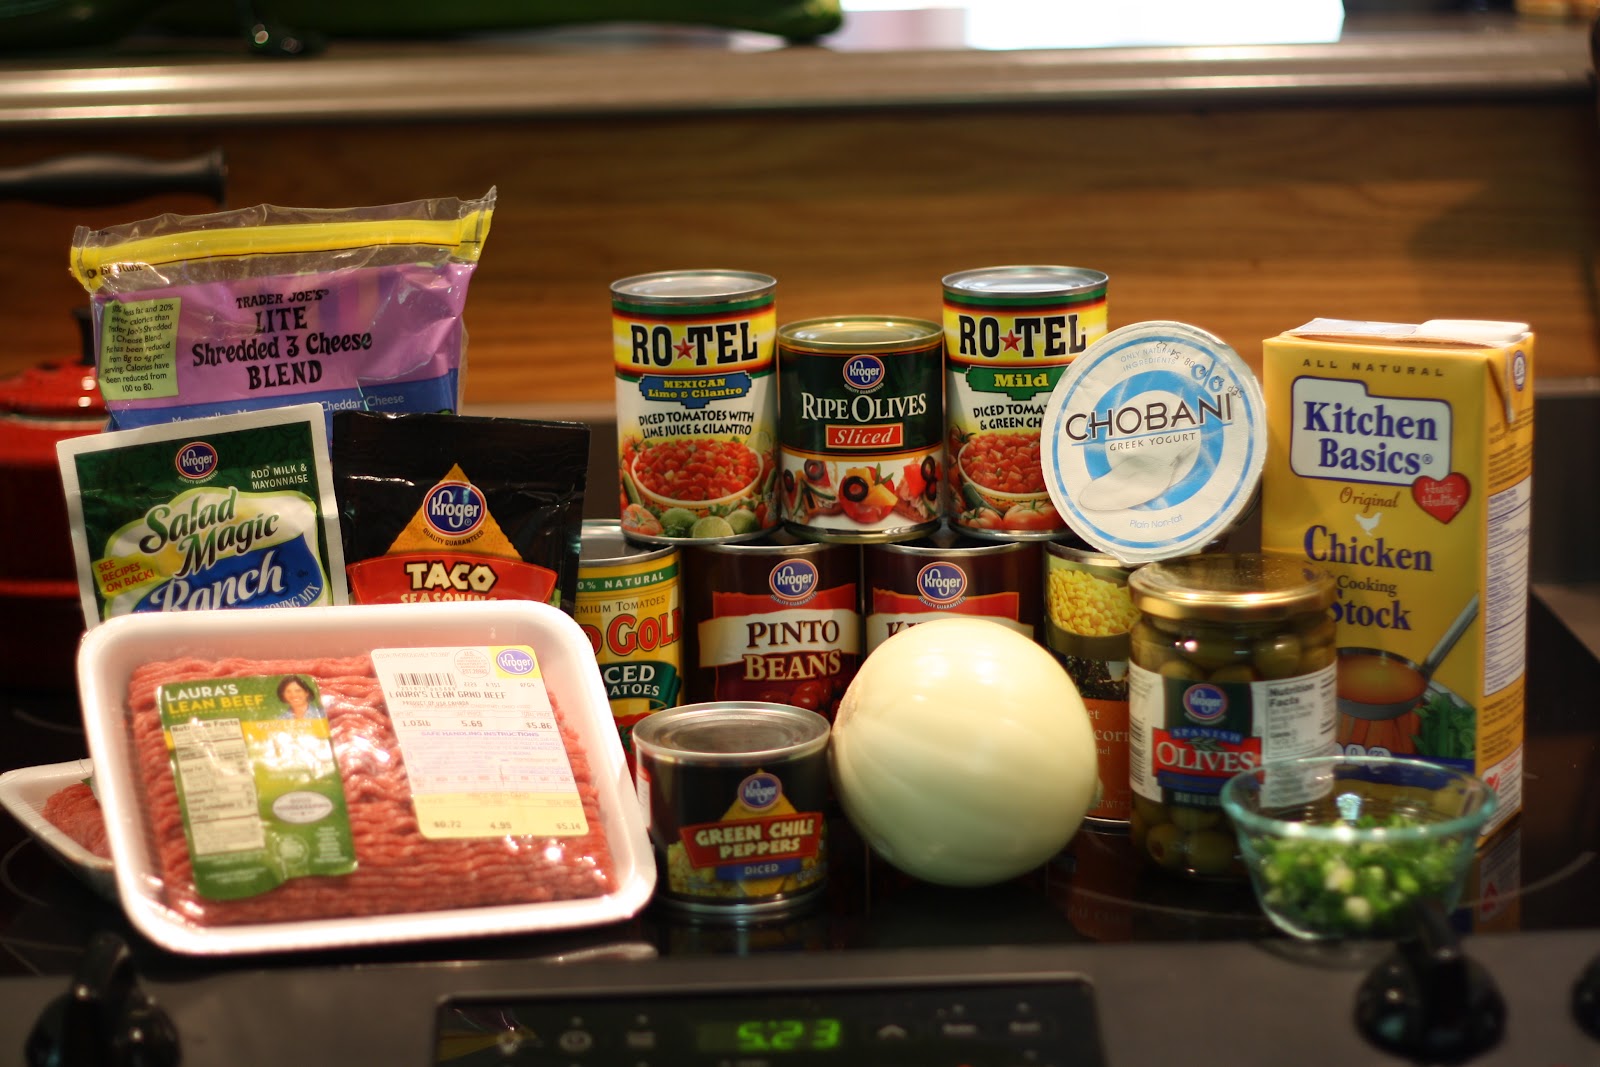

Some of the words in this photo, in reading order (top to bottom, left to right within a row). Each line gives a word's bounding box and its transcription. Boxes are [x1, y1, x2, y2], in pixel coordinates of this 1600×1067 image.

[236, 294, 284, 309] TRADER
[288, 289, 325, 303] JOE'S
[145, 305, 158, 313] and
[143, 323, 173, 333] Shredded
[254, 306, 308, 333] LITE
[116, 335, 143, 343] Cheese
[145, 342, 171, 352] reduced
[192, 336, 280, 366] Shredded
[286, 335, 299, 357] 3
[305, 331, 372, 355] Cheese
[1120, 350, 1141, 363] ONLY
[153, 354, 165, 362] per
[1122, 356, 1176, 372] INGREDIENTS
[122, 373, 149, 381] reduced
[150, 372, 167, 380] from
[126, 364, 153, 372] Calories
[246, 360, 322, 390] BLEND
[849, 360, 880, 384] Kroger
[1302, 358, 1338, 369] ALL
[1351, 361, 1445, 377] NATURAL
[122, 384, 133, 392] 100
[663, 378, 726, 389] MEXICAN
[993, 373, 1049, 387] Mild
[366, 394, 405, 407] Cheese
[648, 389, 678, 398] Lime
[680, 390, 689, 398] &
[691, 387, 743, 398] Cilantro
[801, 392, 849, 421] RIPE
[851, 393, 927, 423] OLIVES
[973, 404, 1005, 418] DICED
[1065, 392, 1233, 441] CHOBANI
[639, 413, 665, 426] DICED
[666, 410, 727, 423] TOMATOES
[729, 411, 755, 423] WITH
[980, 420, 988, 430] &
[988, 418, 1025, 430] GREEN
[1303, 401, 1438, 442] Kitchen
[642, 424, 665, 439] LIME
[666, 424, 692, 436] JUICE
[693, 424, 701, 435] &
[702, 423, 752, 435] CILANTRO
[835, 427, 894, 445] Sliced
[1109, 438, 1145, 452] GREEK
[1148, 432, 1197, 447] YOGURT
[182, 449, 213, 473] Kroger
[1318, 438, 1421, 475] Basics
[250, 468, 270, 480] ADD
[273, 465, 298, 477] MILK
[300, 463, 308, 473] &
[251, 474, 309, 490] MAYONNAISE
[431, 489, 480, 528] Kroger
[1339, 485, 1400, 514] Original
[139, 486, 238, 555] Salad
[1129, 518, 1150, 529] Plain
[1151, 513, 1183, 529] Non-fat
[174, 512, 280, 578] Magic
[422, 528, 446, 545] QUALITY
[445, 529, 484, 546] GUARANTEED
[1303, 524, 1433, 572] Chicken
[98, 559, 115, 573] SEE
[102, 561, 142, 584] RECIPES
[106, 579, 123, 593] ON
[124, 569, 155, 588] BACK!
[150, 550, 286, 613] Ranch
[404, 560, 498, 593] TACO
[604, 571, 665, 589] NATURAL
[776, 565, 813, 593] Kroger
[924, 568, 962, 597] Kroger
[1336, 574, 1397, 597] Cooking
[616, 595, 666, 613] TOMATOES
[746, 619, 840, 648] PINTO
[500, 653, 531, 671] Kroger
[742, 649, 842, 682] BEANS
[165, 683, 239, 702] LAURA'S
[389, 691, 428, 699] LAURA'S
[430, 691, 455, 699] LEAN
[457, 691, 482, 699] GRND
[484, 691, 507, 699] BEEF
[168, 699, 216, 716] LEAN
[222, 693, 265, 709] BEEF
[461, 719, 483, 728] 5.69
[526, 721, 553, 730] $5.86
[1172, 727, 1242, 743] SPANISH
[1156, 741, 1255, 772] OLIVES
[744, 779, 777, 804] Kroger
[695, 824, 762, 846] GREEN
[769, 818, 814, 839] CHILE
[719, 837, 800, 859] PEPPERS
[744, 863, 779, 876] DICED
